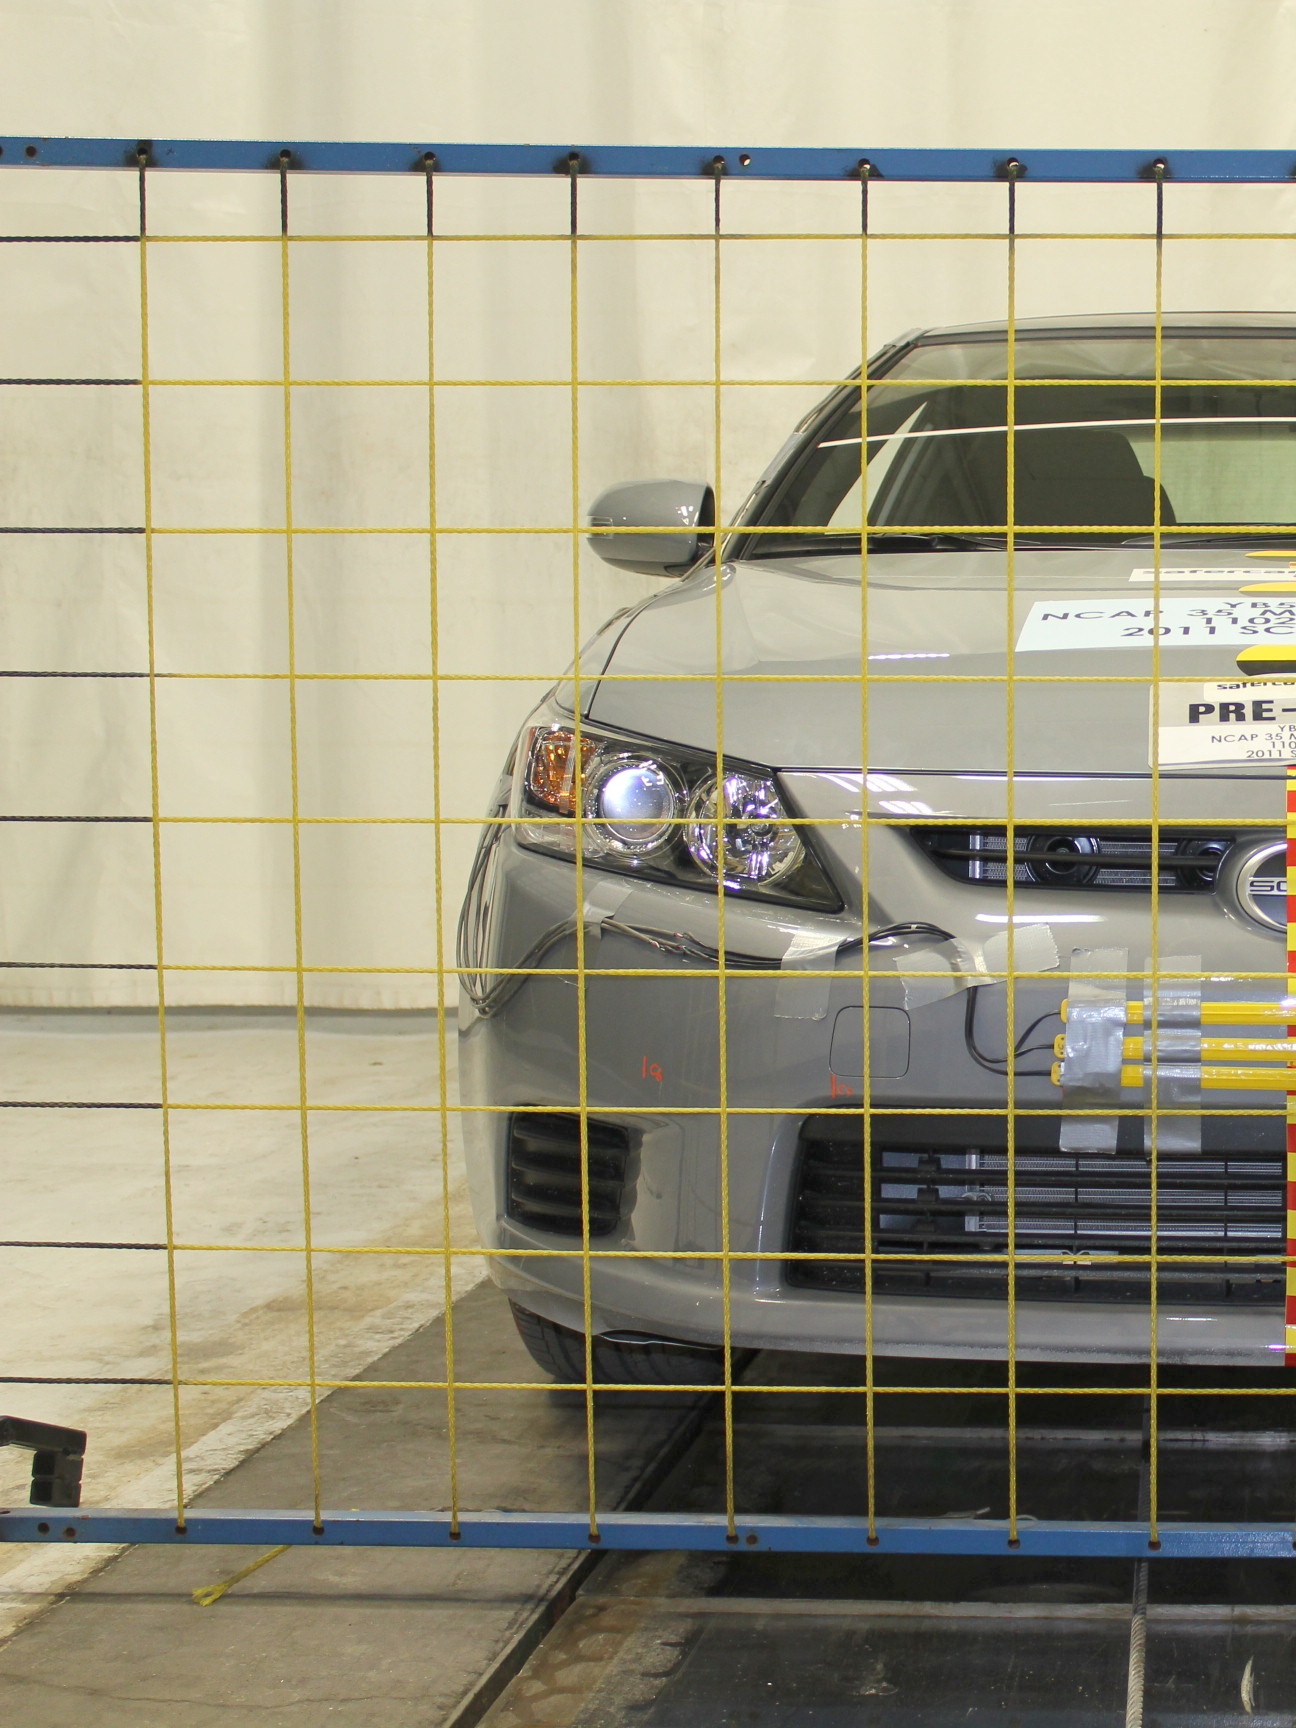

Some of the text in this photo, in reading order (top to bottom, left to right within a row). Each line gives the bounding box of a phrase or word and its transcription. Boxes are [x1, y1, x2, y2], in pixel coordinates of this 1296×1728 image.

[1041, 609, 1164, 621] NCAP
[1186, 609, 1234, 617] 35
[1120, 625, 1217, 637] 2011
[1211, 732, 1259, 744] NCAP
[1264, 732, 1284, 742] 35
[1245, 749, 1283, 760] 2011
